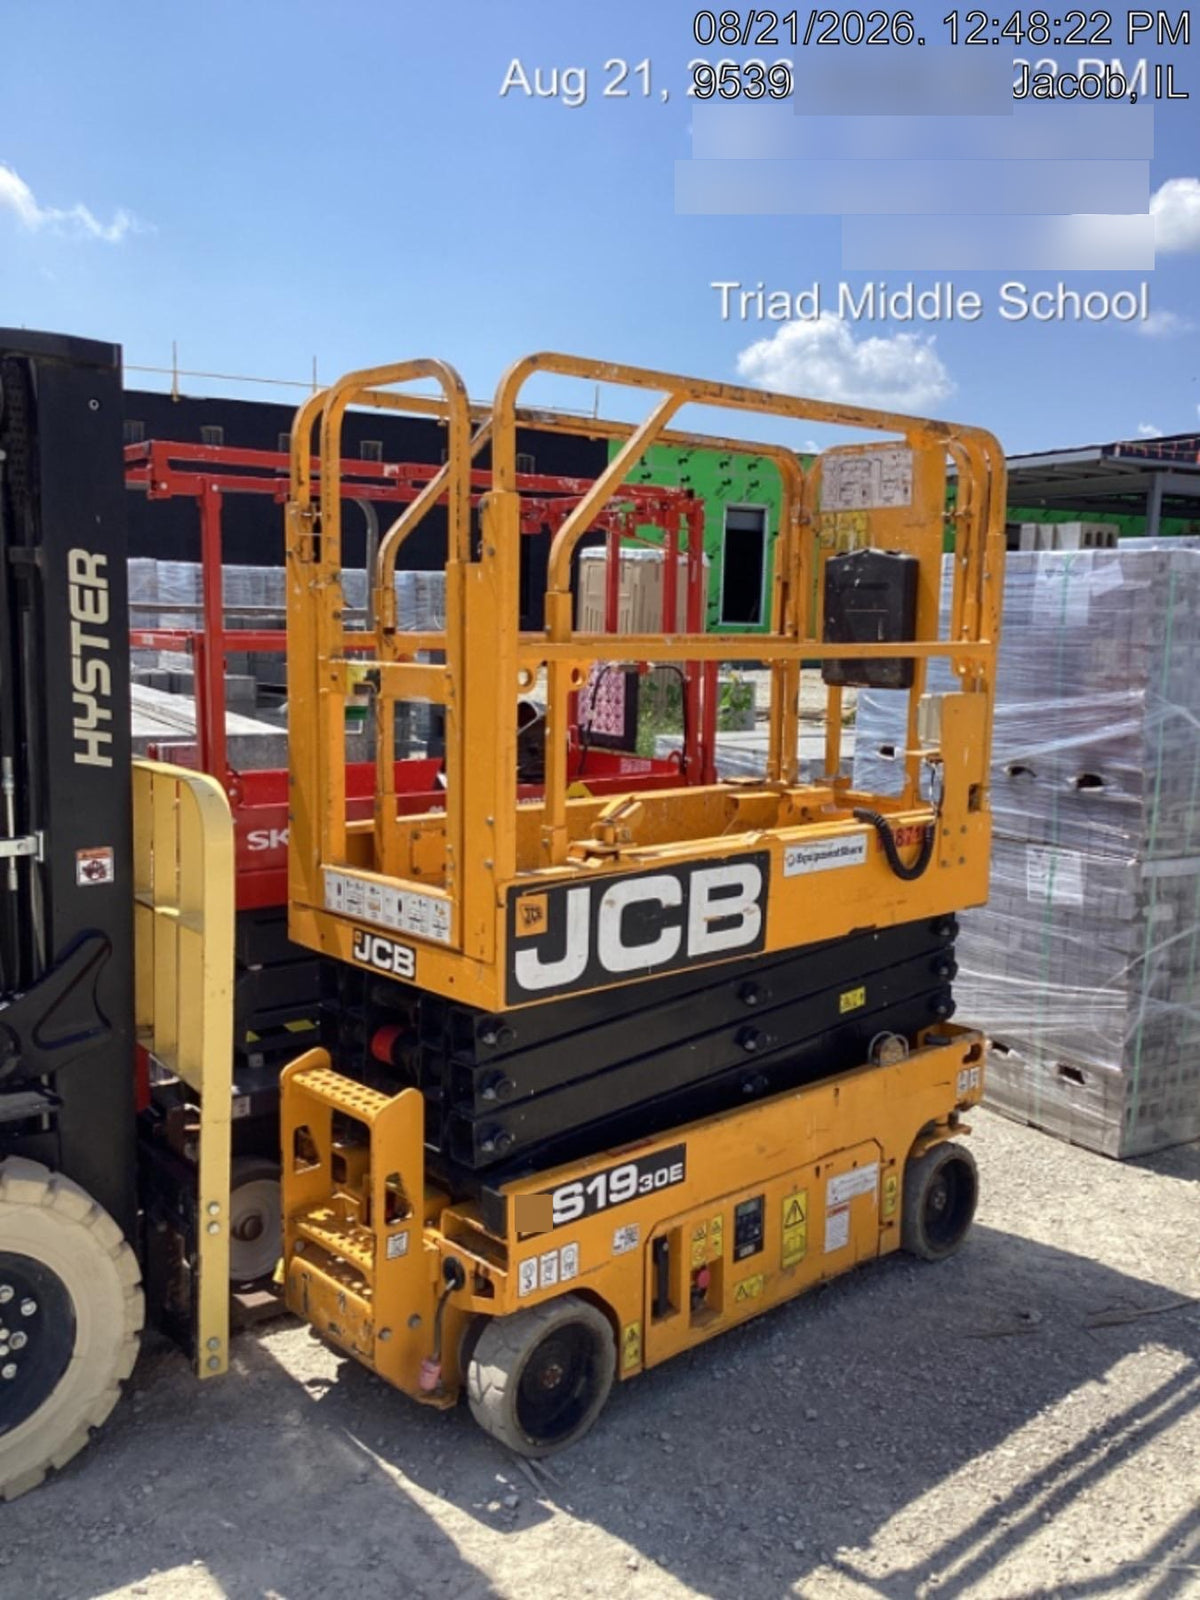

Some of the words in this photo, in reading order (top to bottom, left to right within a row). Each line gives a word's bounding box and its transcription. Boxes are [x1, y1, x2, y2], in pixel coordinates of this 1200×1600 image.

[68, 548, 113, 767] HYSTER
[354, 934, 415, 977] JCB
[515, 863, 763, 990] JCB
